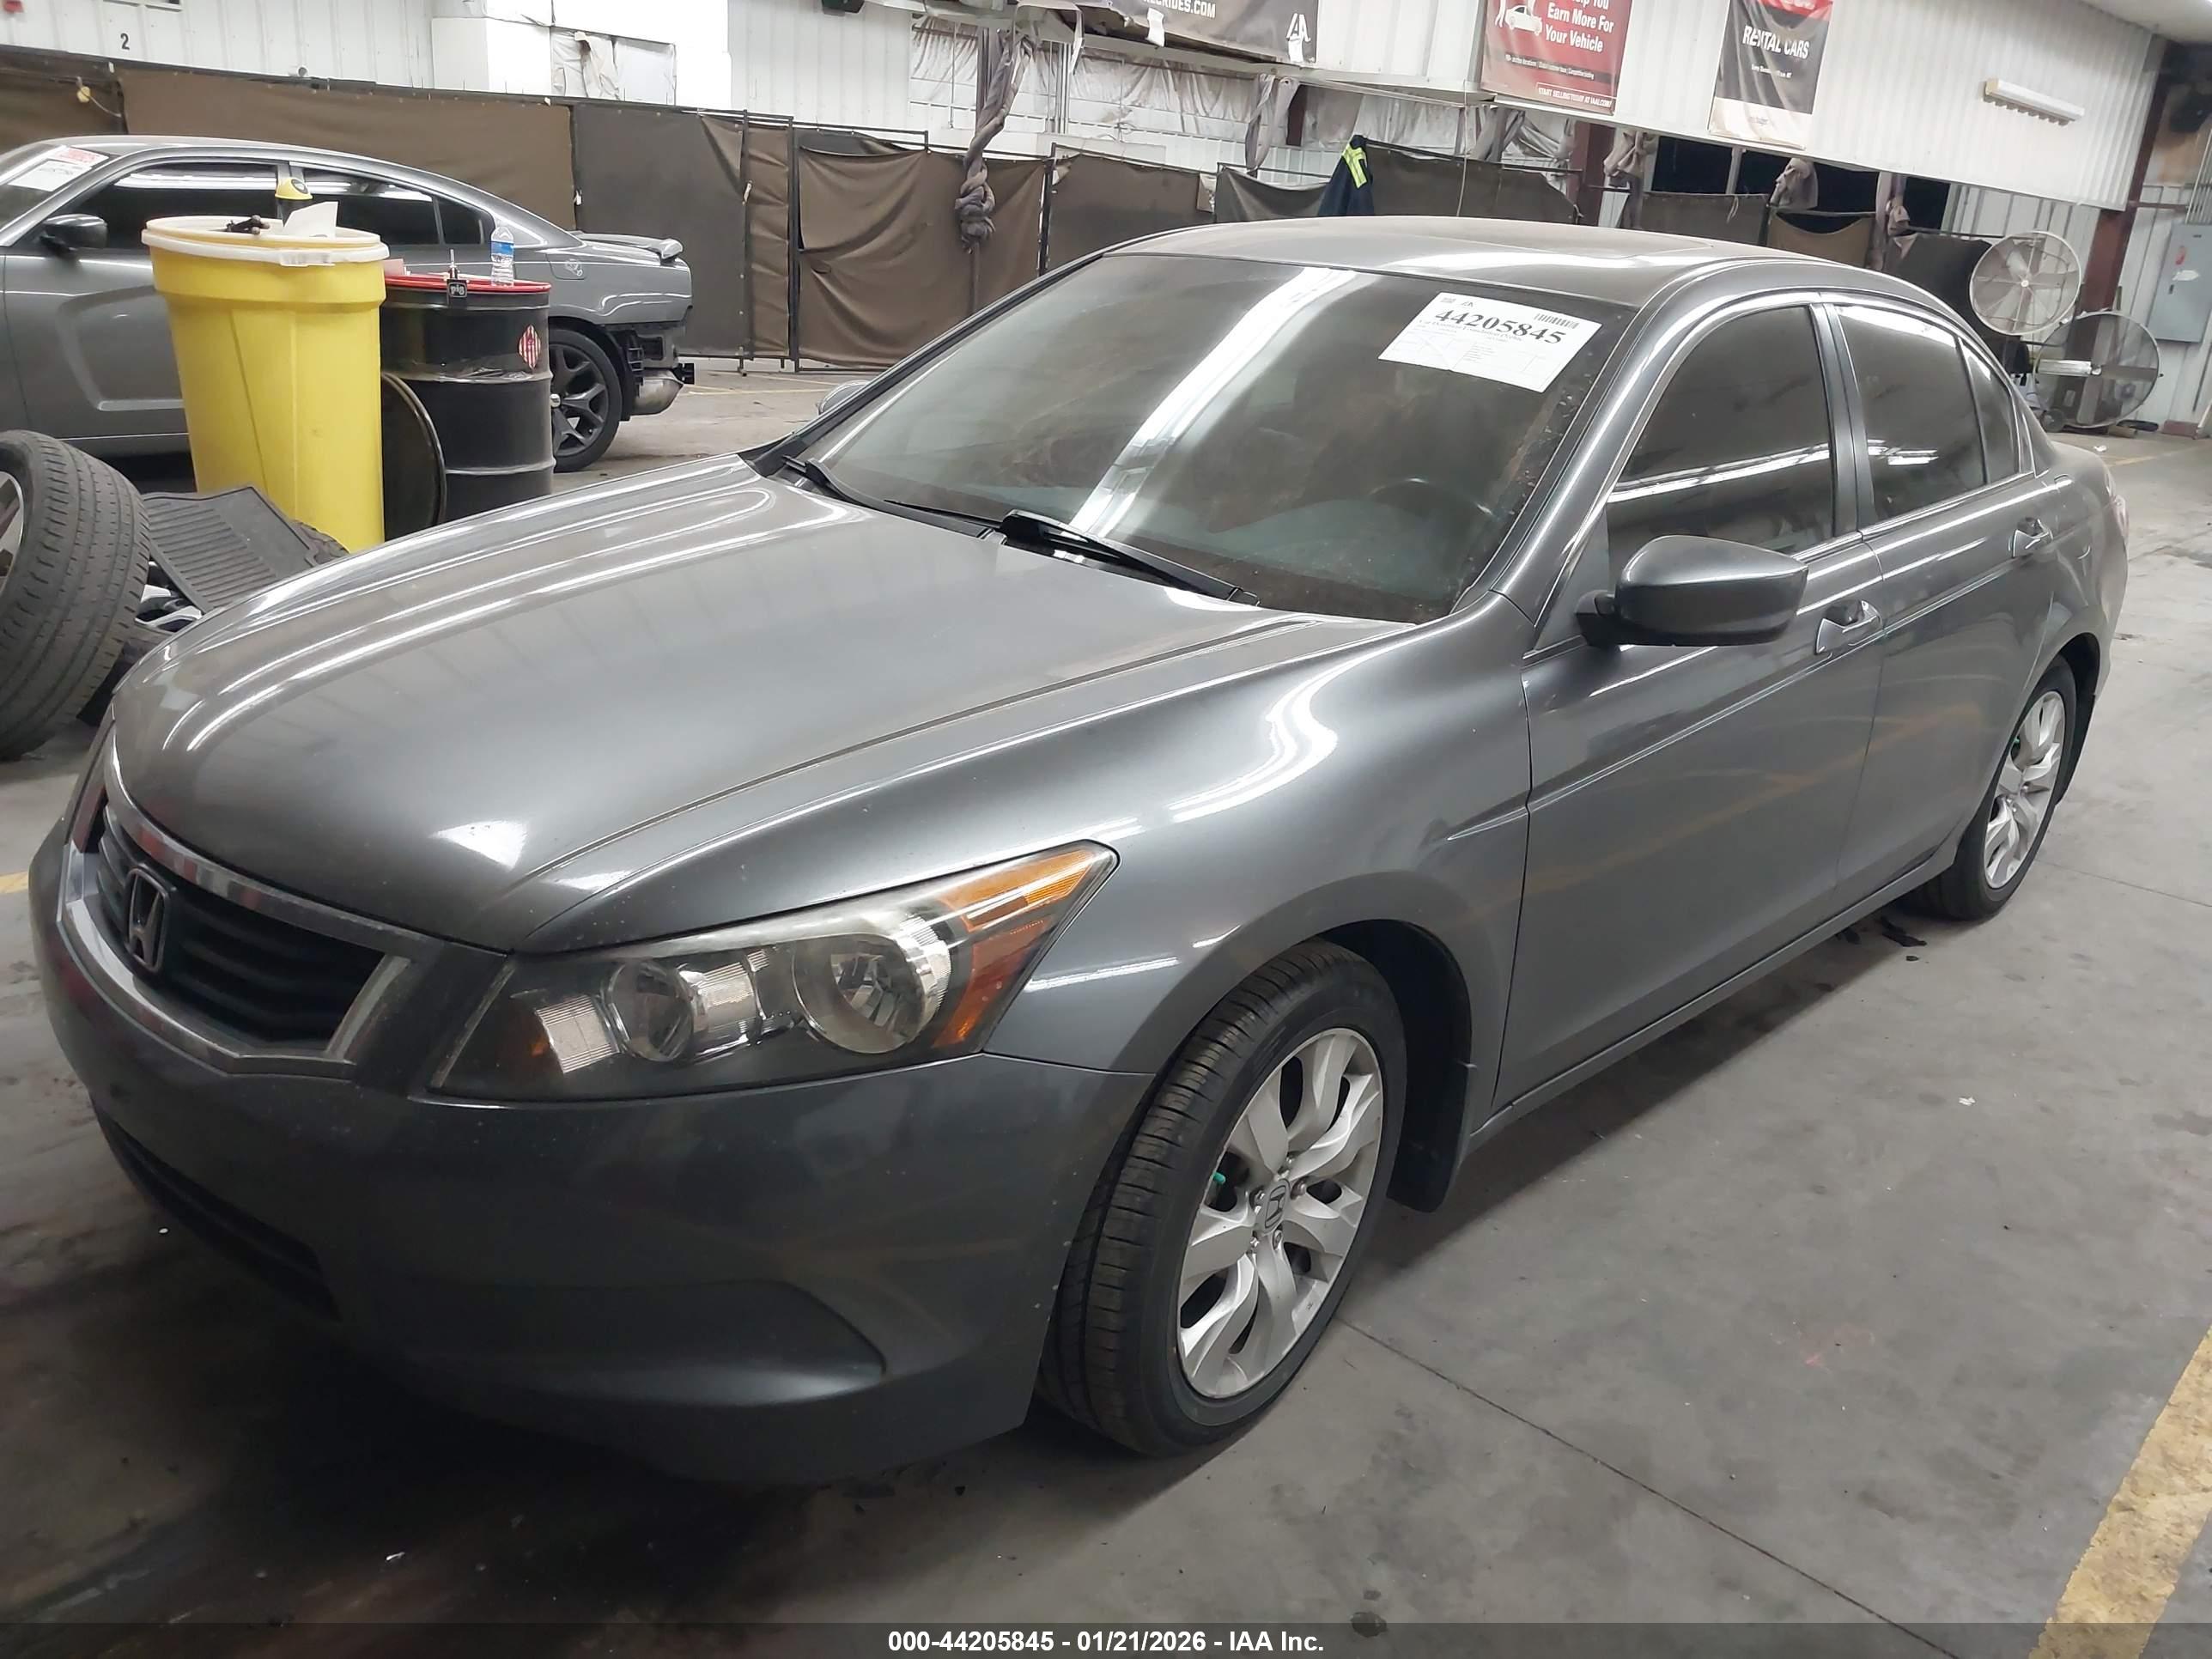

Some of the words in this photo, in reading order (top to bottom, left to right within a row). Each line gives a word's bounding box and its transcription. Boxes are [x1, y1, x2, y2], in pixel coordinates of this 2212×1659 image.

[1547, 2, 1570, 22] Earn
[1571, 9, 1598, 29] More
[1598, 15, 1614, 33] For
[120, 33, 131, 51] 2
[1545, 24, 1568, 44] Your
[1570, 30, 1604, 52] Vehicle
[1742, 25, 1782, 53] RENTAL
[1784, 40, 1809, 59] CARS
[1435, 309, 1566, 344] 44205845
